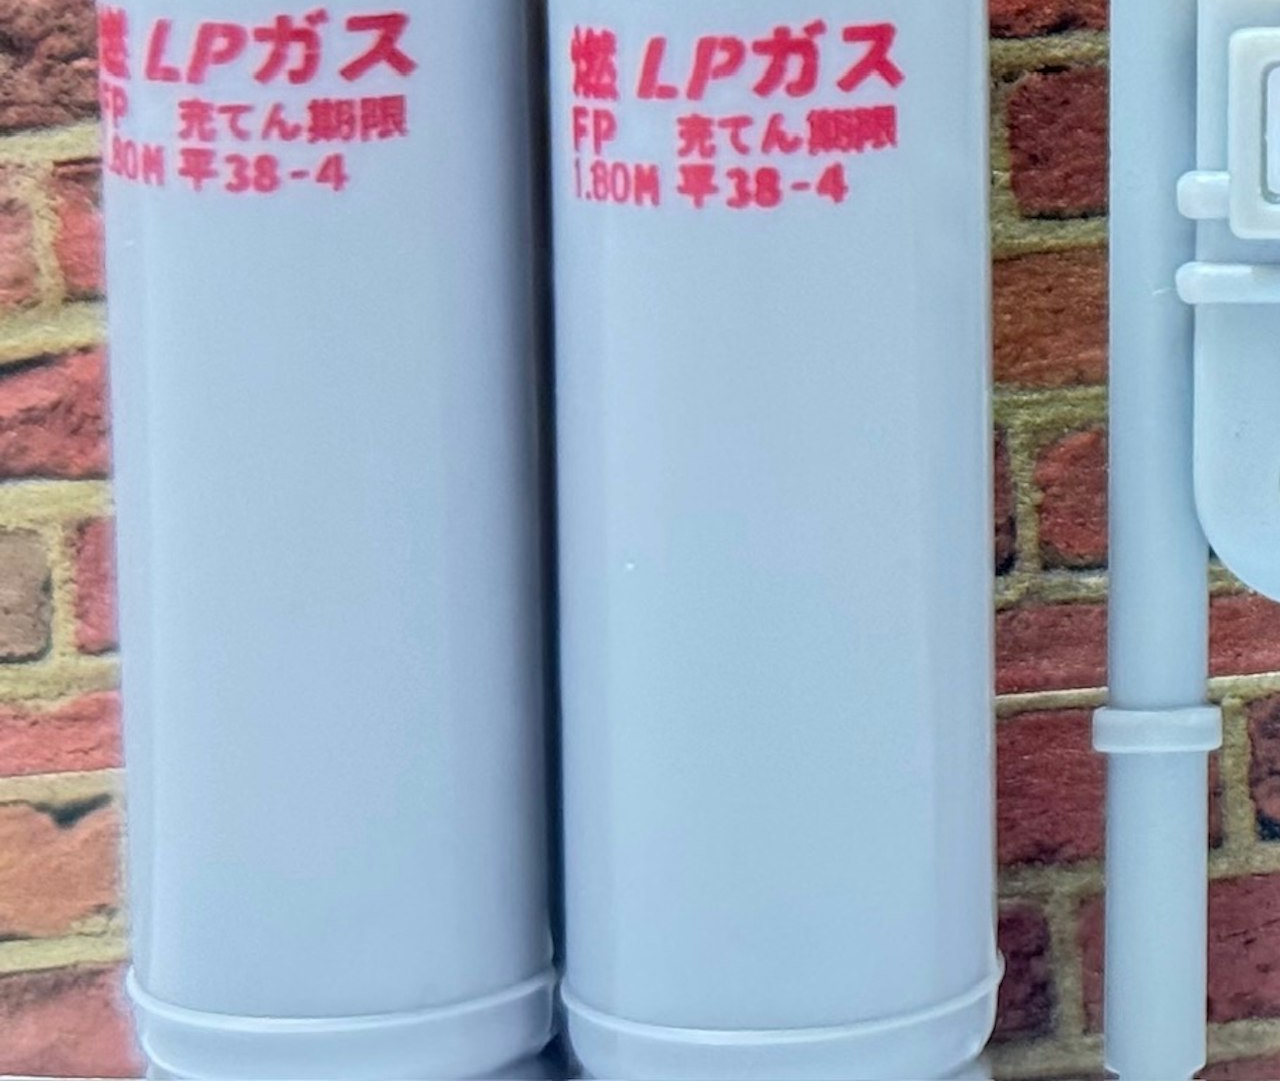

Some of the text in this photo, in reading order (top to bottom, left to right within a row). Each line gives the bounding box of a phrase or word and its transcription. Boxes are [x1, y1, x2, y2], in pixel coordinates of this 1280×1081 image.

[145, 9, 417, 84] LPガス
[637, 19, 906, 101] LPガス
[178, 94, 408, 144] 充てん期限
[571, 105, 617, 154] FP
